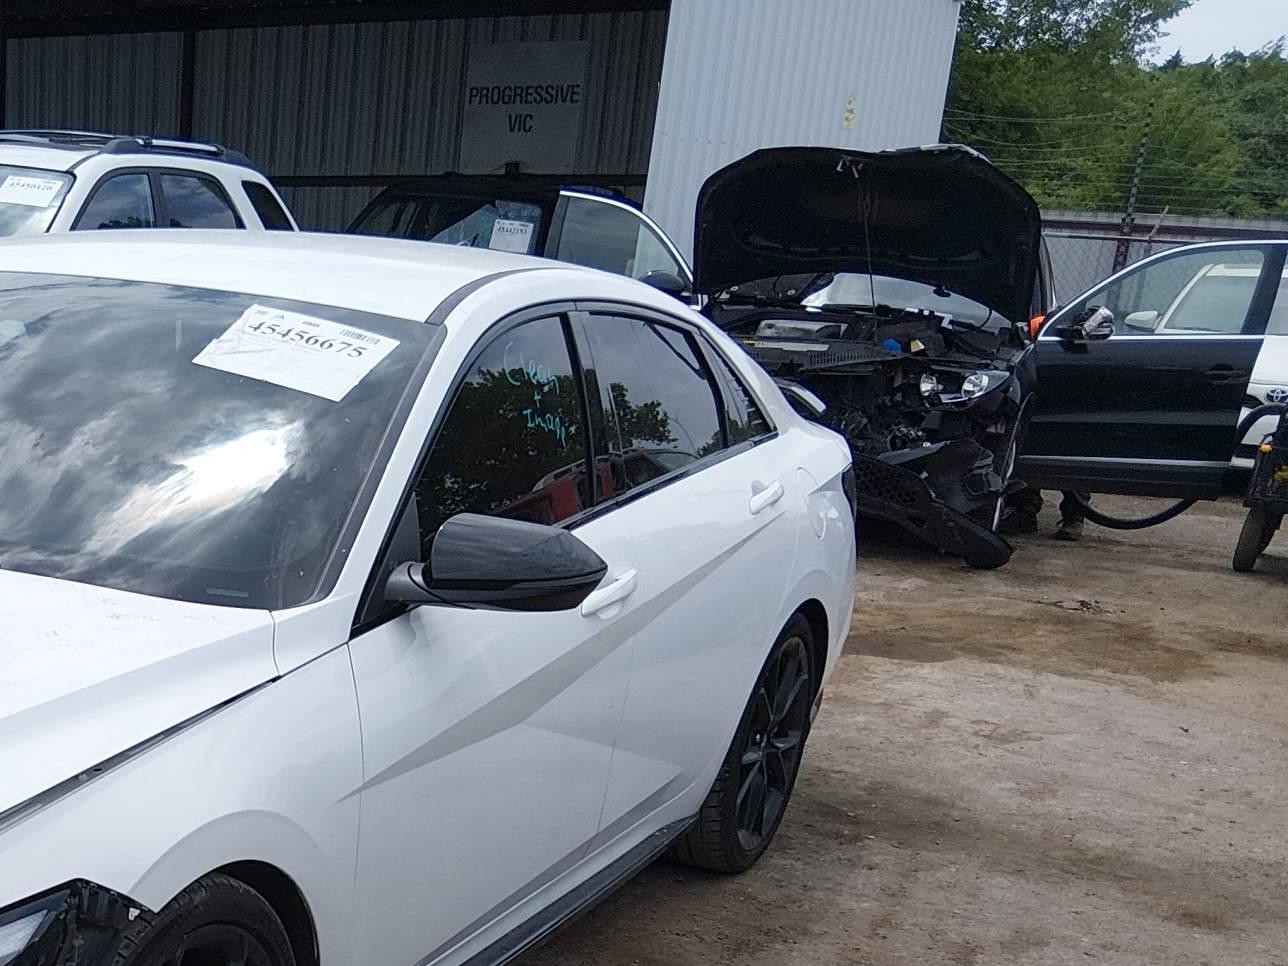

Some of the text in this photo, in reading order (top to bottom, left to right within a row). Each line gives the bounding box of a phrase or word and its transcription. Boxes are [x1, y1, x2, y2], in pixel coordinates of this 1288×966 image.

[469, 84, 581, 105] PROGRESSIVE
[508, 113, 534, 134] VIC
[248, 320, 368, 359] 45456675
